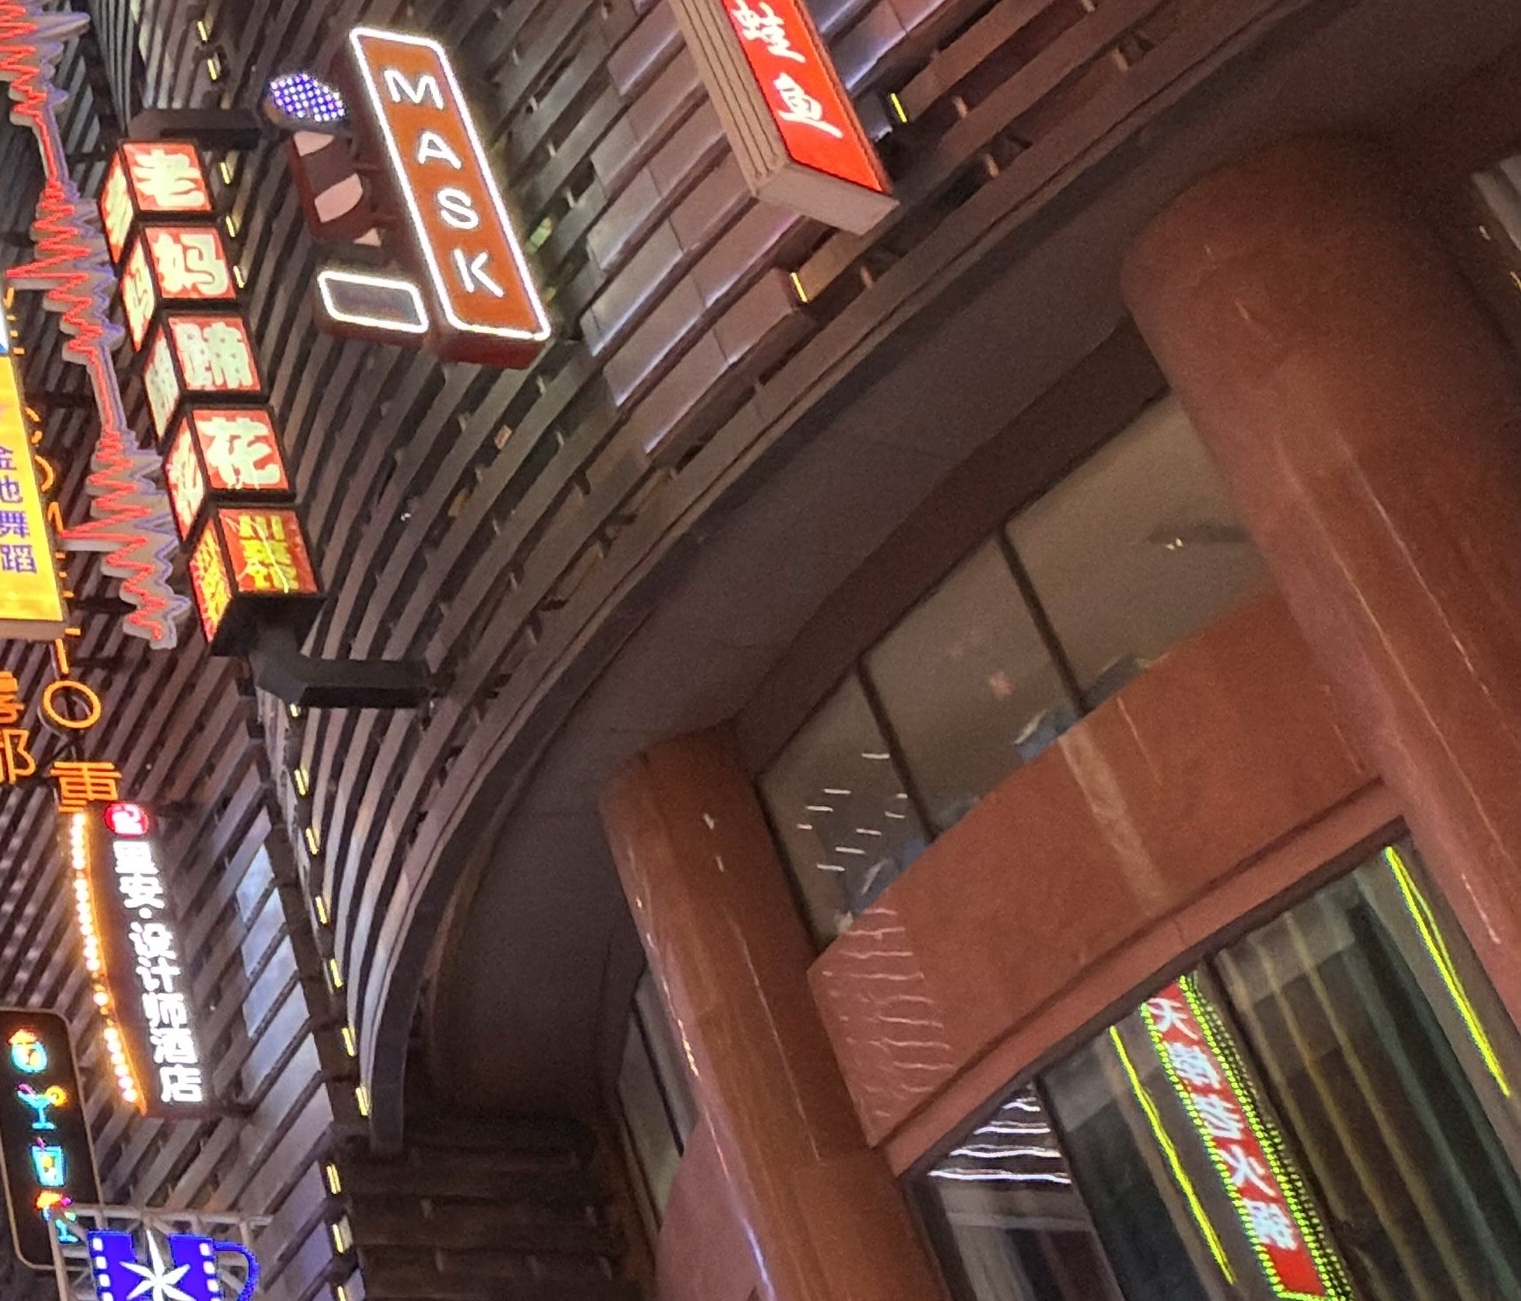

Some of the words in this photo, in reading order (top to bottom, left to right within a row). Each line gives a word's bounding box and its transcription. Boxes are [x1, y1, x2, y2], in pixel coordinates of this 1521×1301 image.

[132, 149, 280, 489] 老妈蹄花
[384, 70, 505, 298] MASK
